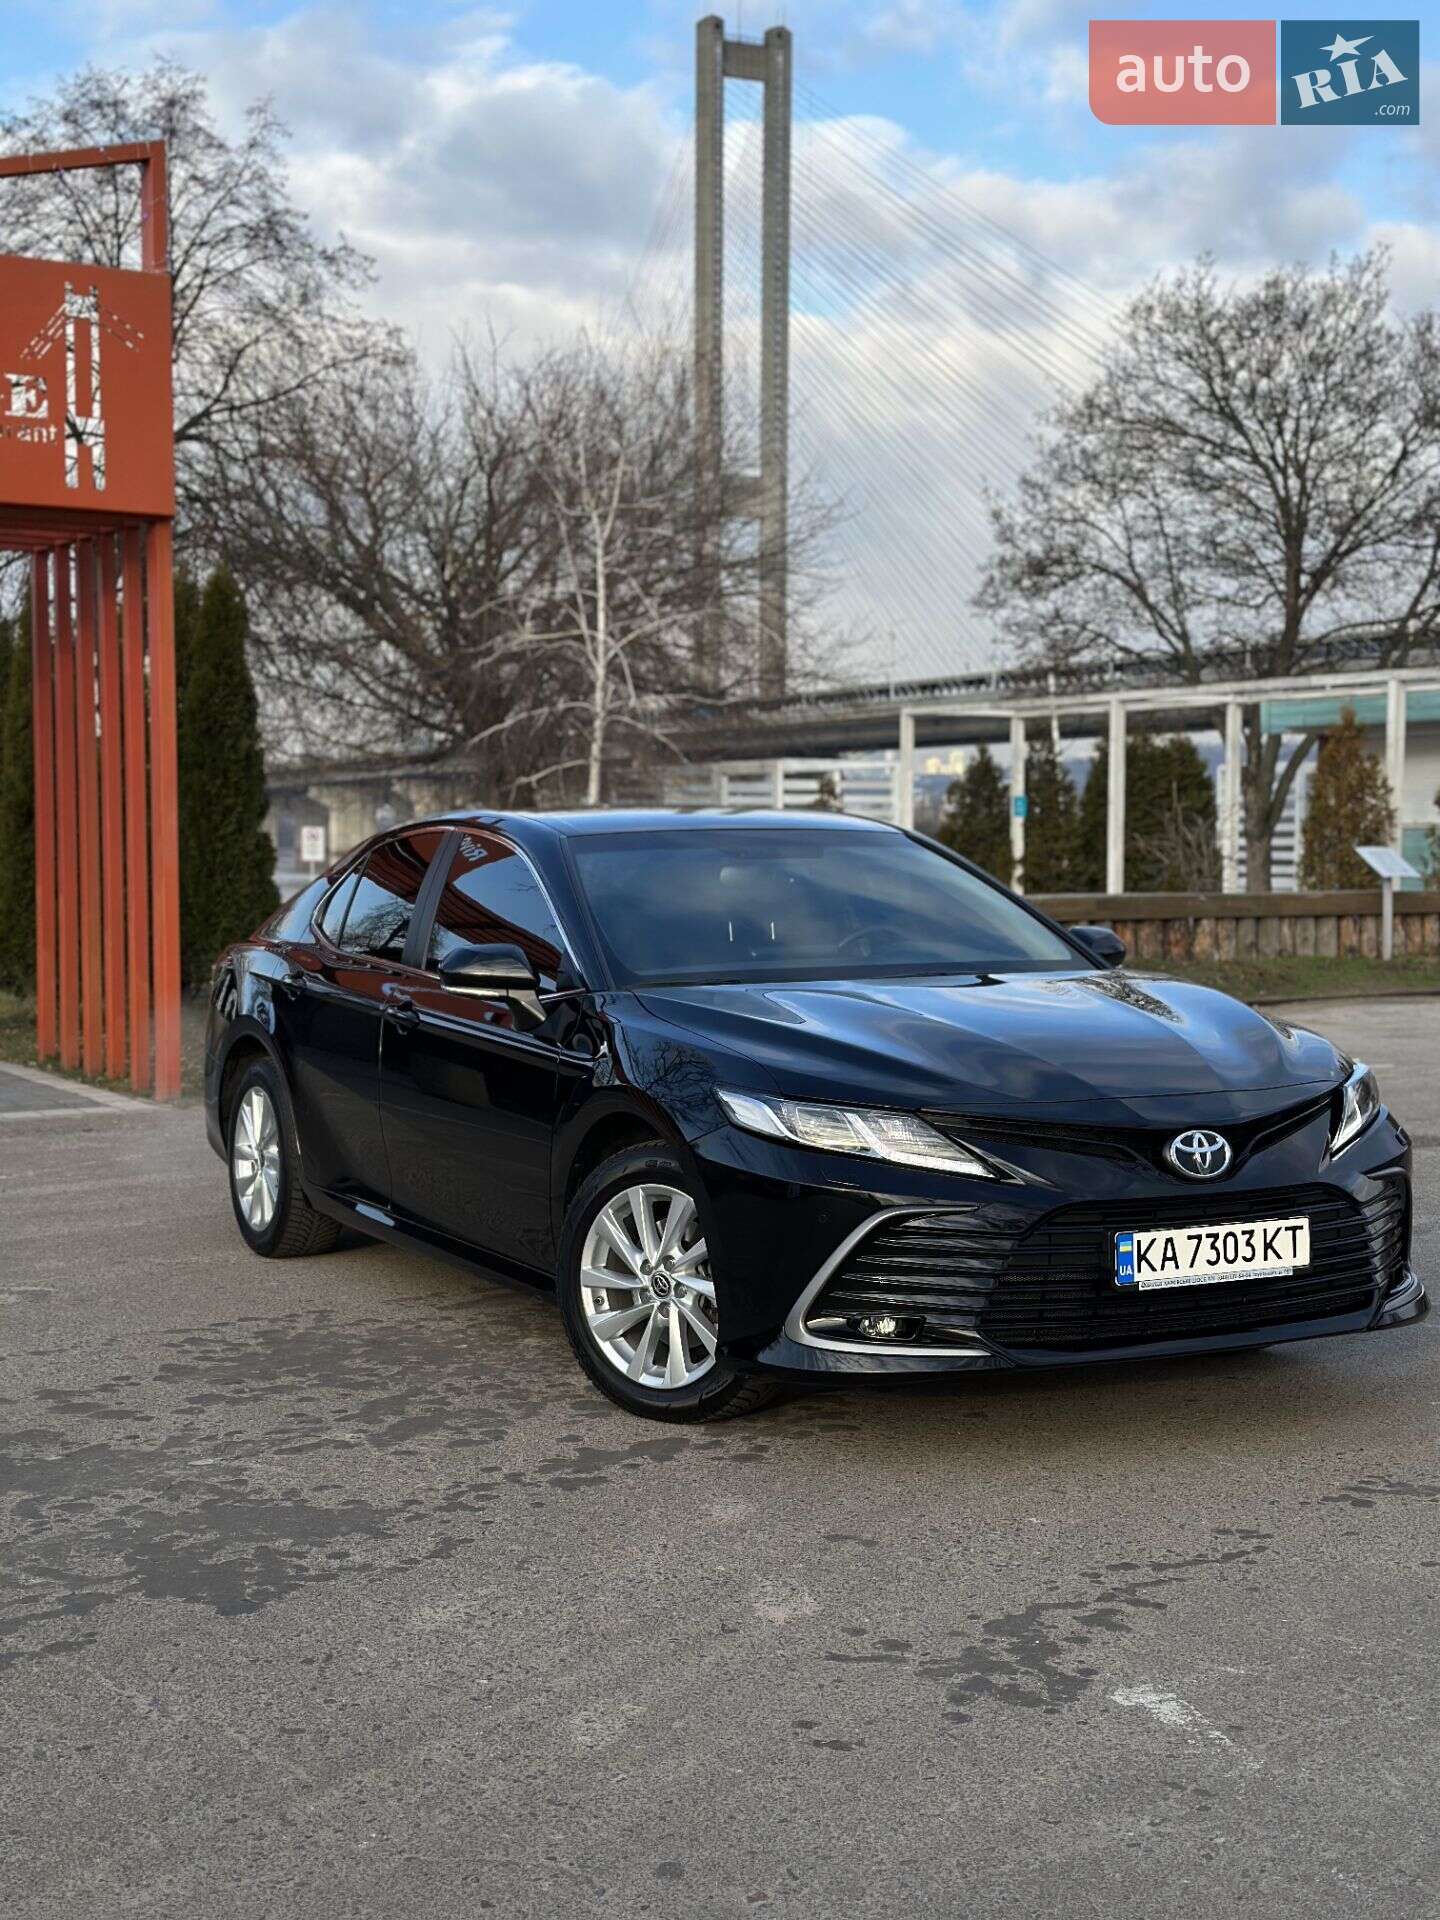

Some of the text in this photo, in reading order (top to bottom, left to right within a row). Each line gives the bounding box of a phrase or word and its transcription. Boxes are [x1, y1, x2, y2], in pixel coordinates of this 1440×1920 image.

[1136, 1225, 1304, 1274] KA 7303 KT
[1119, 1266, 1133, 1276] UA
